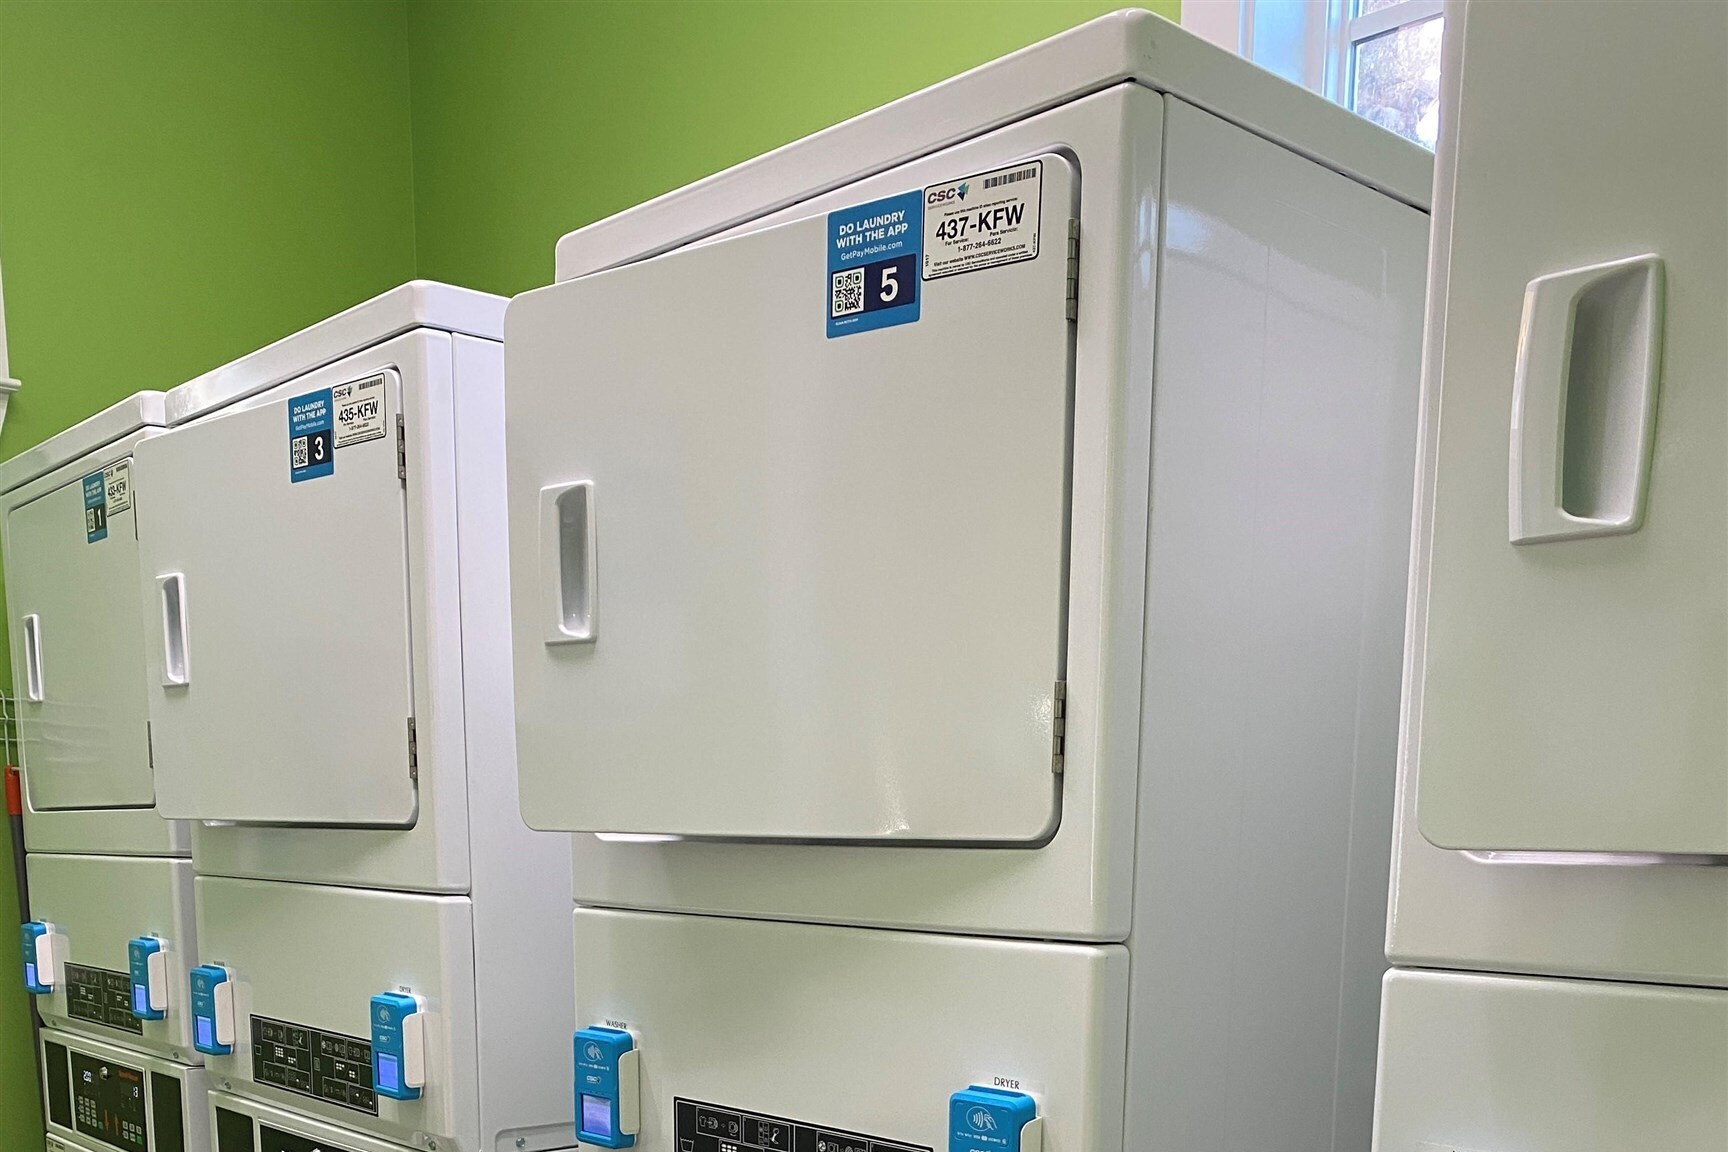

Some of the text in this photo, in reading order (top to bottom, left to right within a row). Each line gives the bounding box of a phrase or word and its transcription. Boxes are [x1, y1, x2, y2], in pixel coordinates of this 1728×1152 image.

[928, 188, 956, 204] CSC
[839, 210, 906, 236] DO LAUNDRY
[936, 202, 1025, 241] 437-KFW
[836, 223, 908, 249] WITH THE APP
[841, 241, 903, 261] GetPayMobile.com
[880, 266, 899, 302] 5
[334, 388, 347, 399] CSC
[293, 407, 327, 423] WITH THE APP
[294, 400, 325, 415] DO LAUNDRY
[339, 400, 378, 423] 435-KFW
[314, 436, 324, 461] 3
[97, 508, 102, 527] 1
[606, 1019, 628, 1030] WASHER
[994, 1077, 1020, 1090] DRYER
